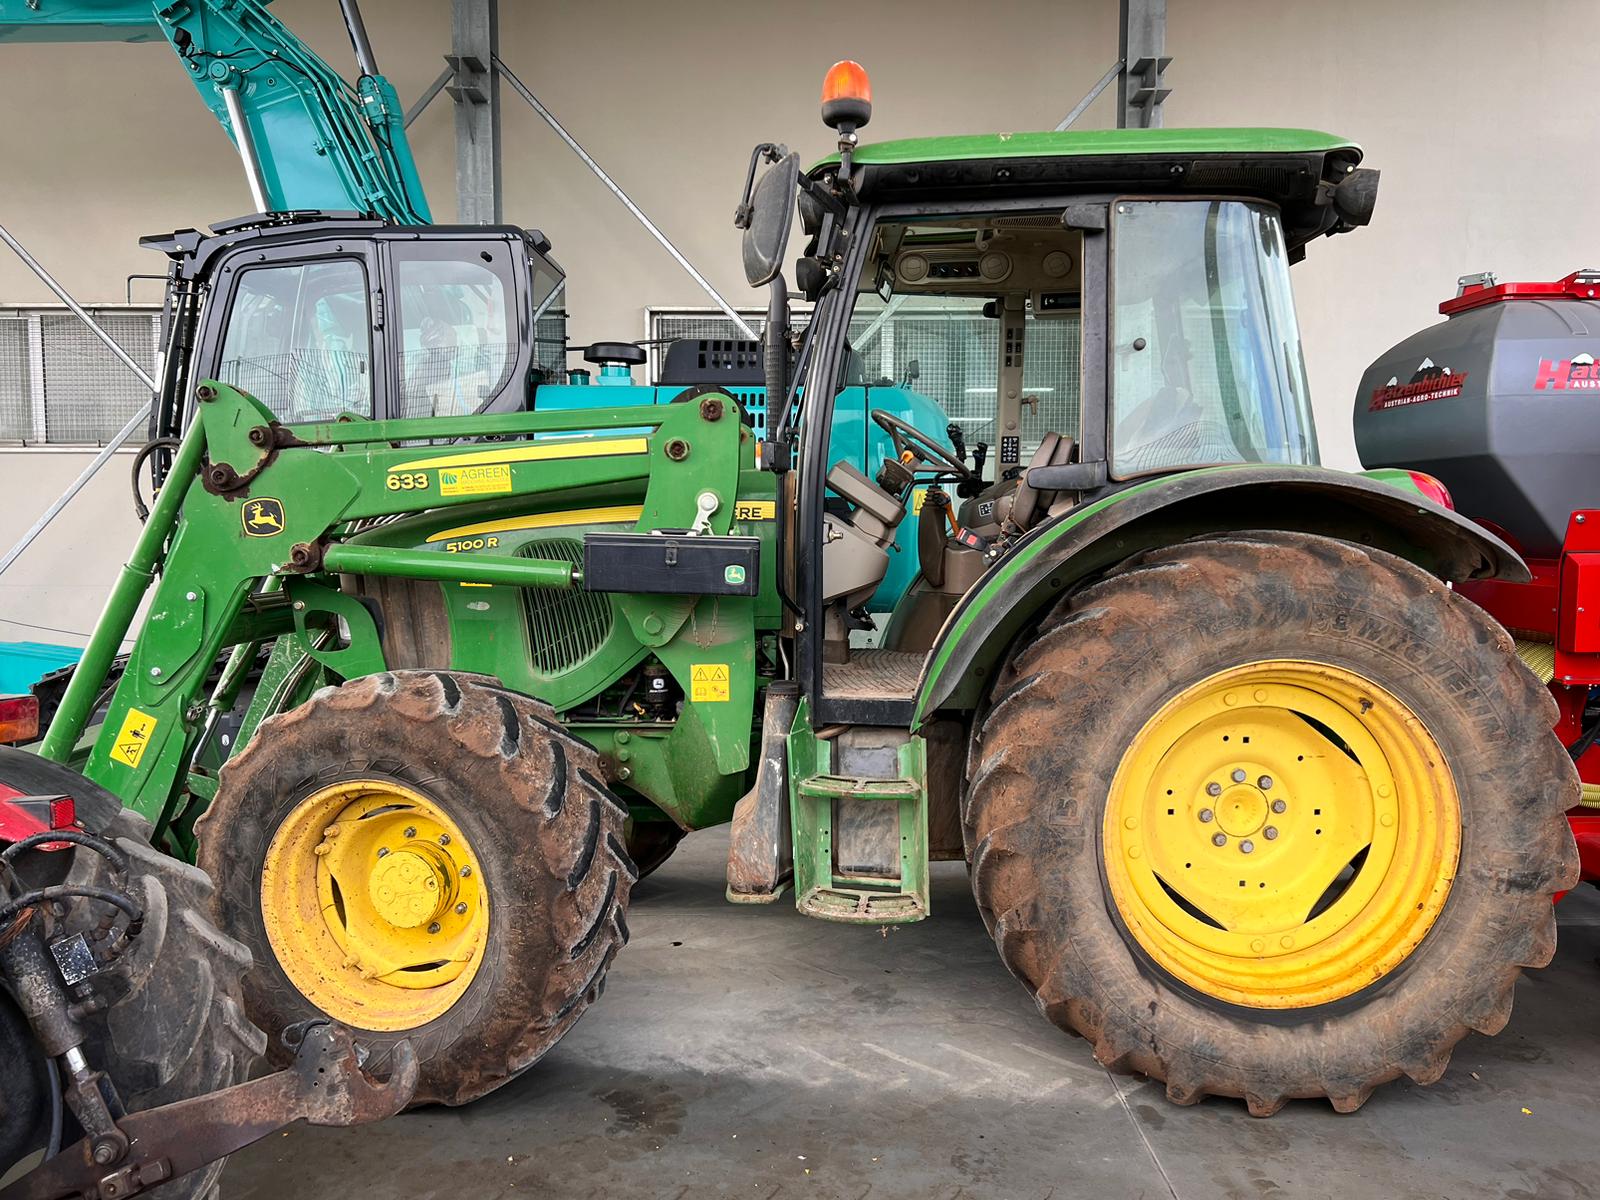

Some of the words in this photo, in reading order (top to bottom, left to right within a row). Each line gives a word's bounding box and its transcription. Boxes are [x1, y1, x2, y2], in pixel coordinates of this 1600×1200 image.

[1368, 369, 1469, 412] Hatzenbichler
[386, 472, 430, 491] 633
[461, 467, 509, 480] AGREEN
[735, 507, 762, 518] RE
[446, 539, 484, 554] 5100
[487, 537, 498, 548] R
